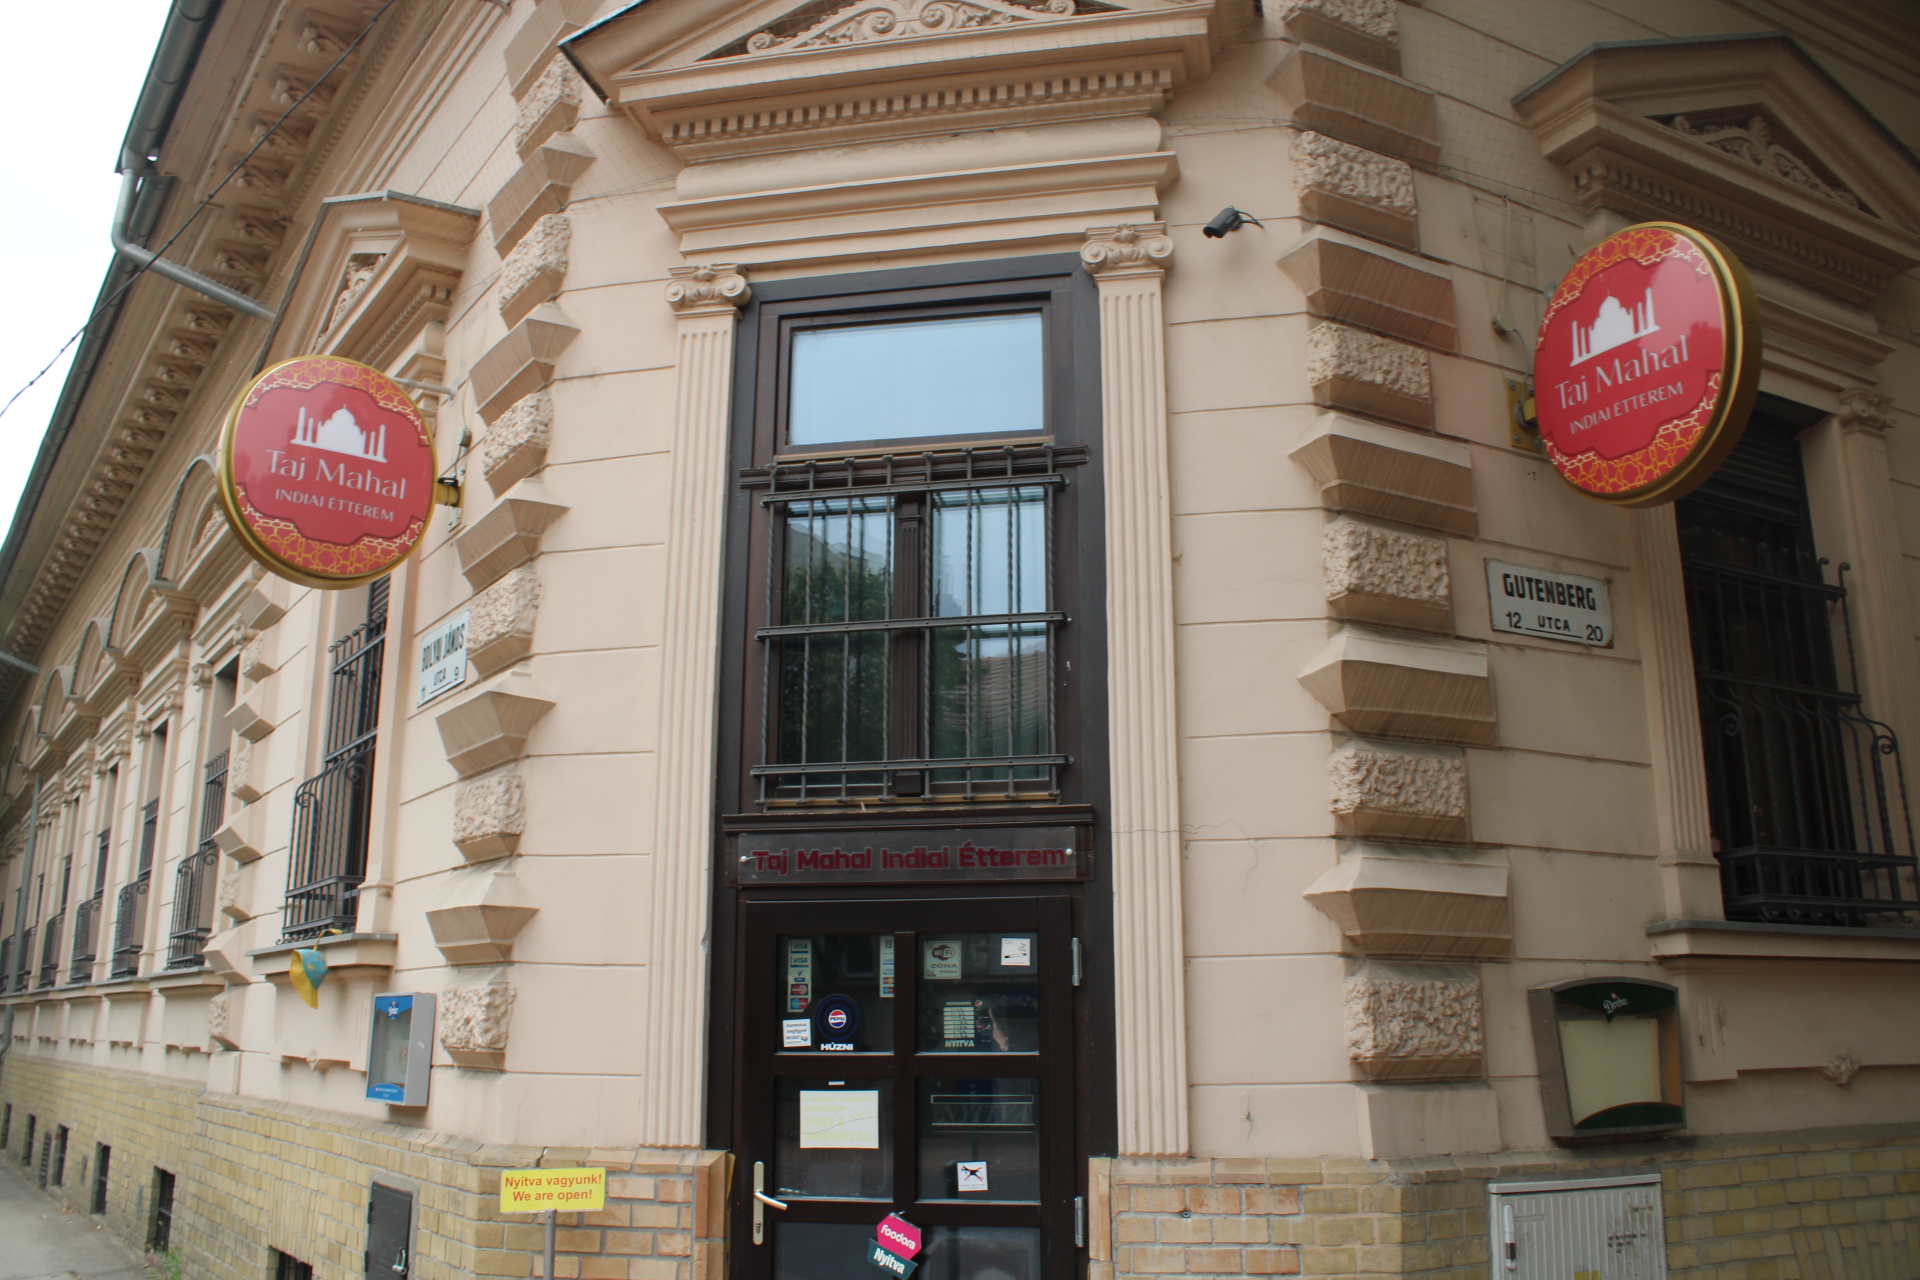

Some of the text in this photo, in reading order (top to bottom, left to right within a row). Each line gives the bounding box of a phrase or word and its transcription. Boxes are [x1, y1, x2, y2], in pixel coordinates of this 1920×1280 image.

[1554, 334, 1689, 409] Taj Mahal
[1570, 407, 1611, 435] INDIAI
[266, 449, 407, 500] Taj Mahal
[275, 489, 394, 522] INDIAI ÉTTEREM
[1502, 573, 1597, 611] GUTENBERG
[1505, 611, 1603, 642] 12 UTCA 20
[752, 839, 1067, 875] Taj Mahal Indiai Étterem
[820, 1042, 854, 1051] HÚZNI
[945, 1040, 975, 1048] NYITVA
[505, 1174, 602, 1190] Nyitva vagyunk!
[513, 1189, 592, 1202] We are open!
[880, 1224, 916, 1250] foodora
[873, 1247, 905, 1275] Nyitva
